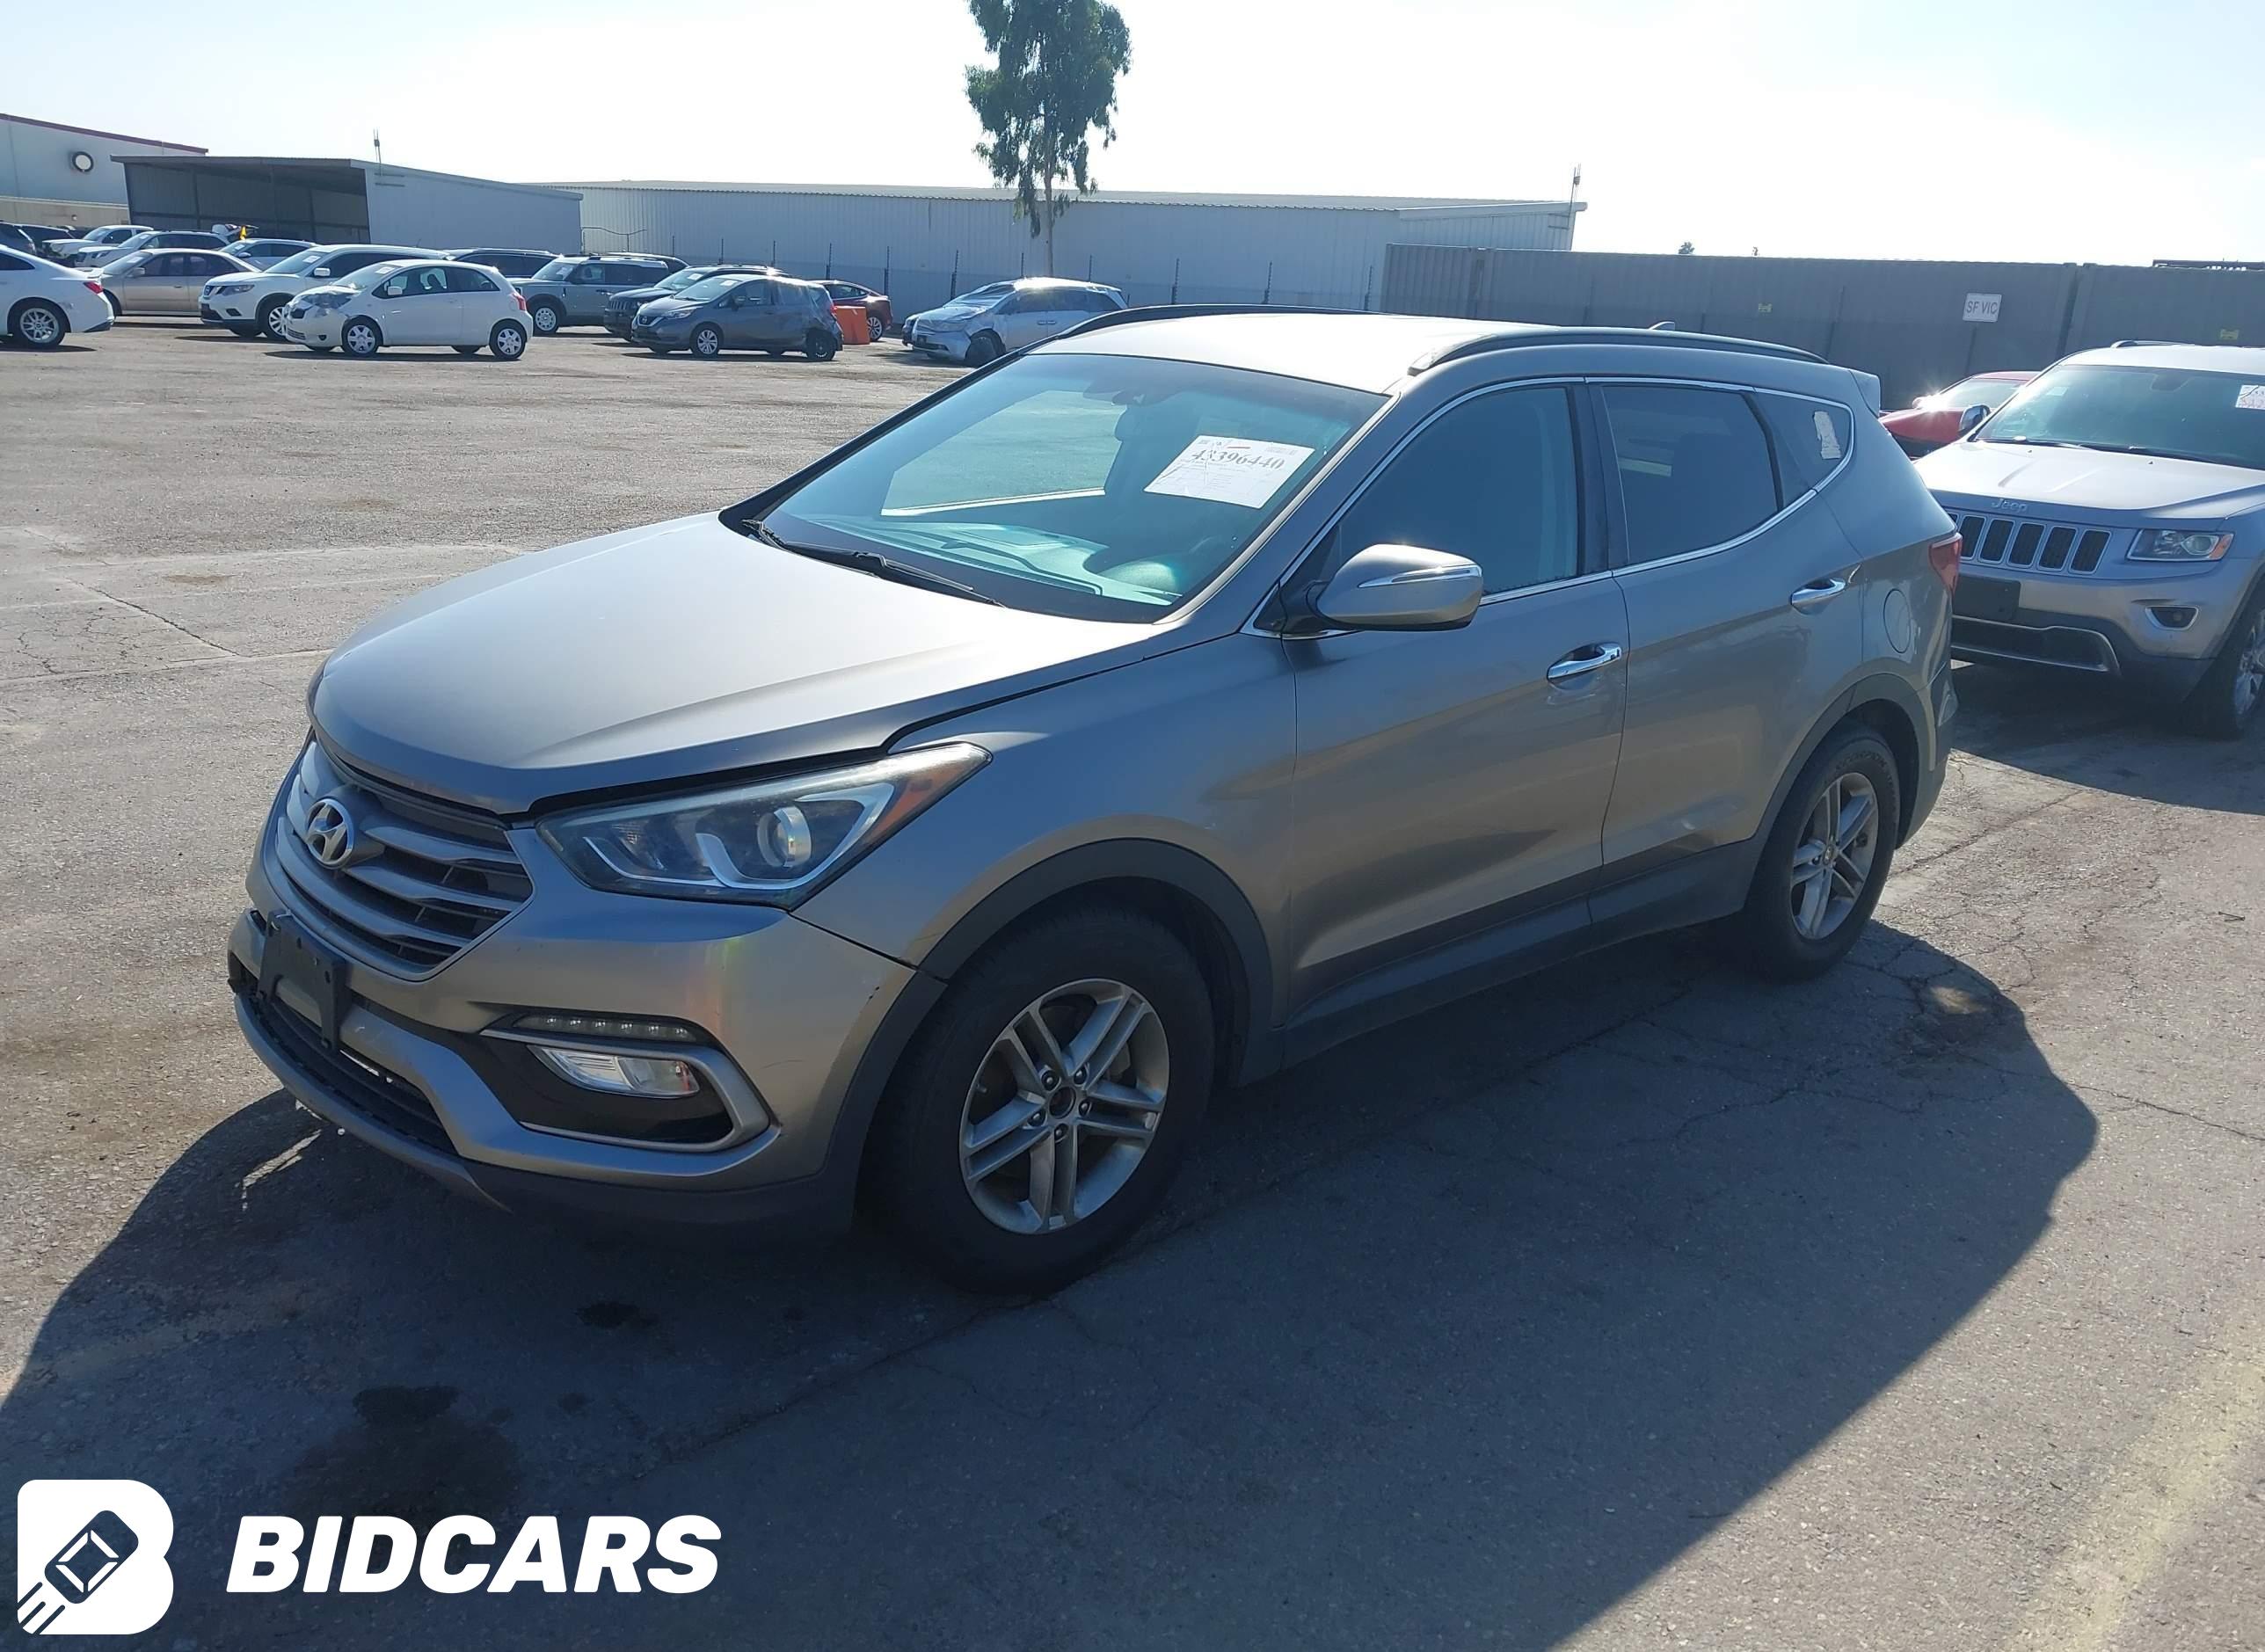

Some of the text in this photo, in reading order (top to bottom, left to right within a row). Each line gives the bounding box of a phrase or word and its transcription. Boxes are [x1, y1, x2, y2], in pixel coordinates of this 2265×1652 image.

[1966, 301, 1998, 315] SF VIC
[1991, 498, 2027, 513] Jeep
